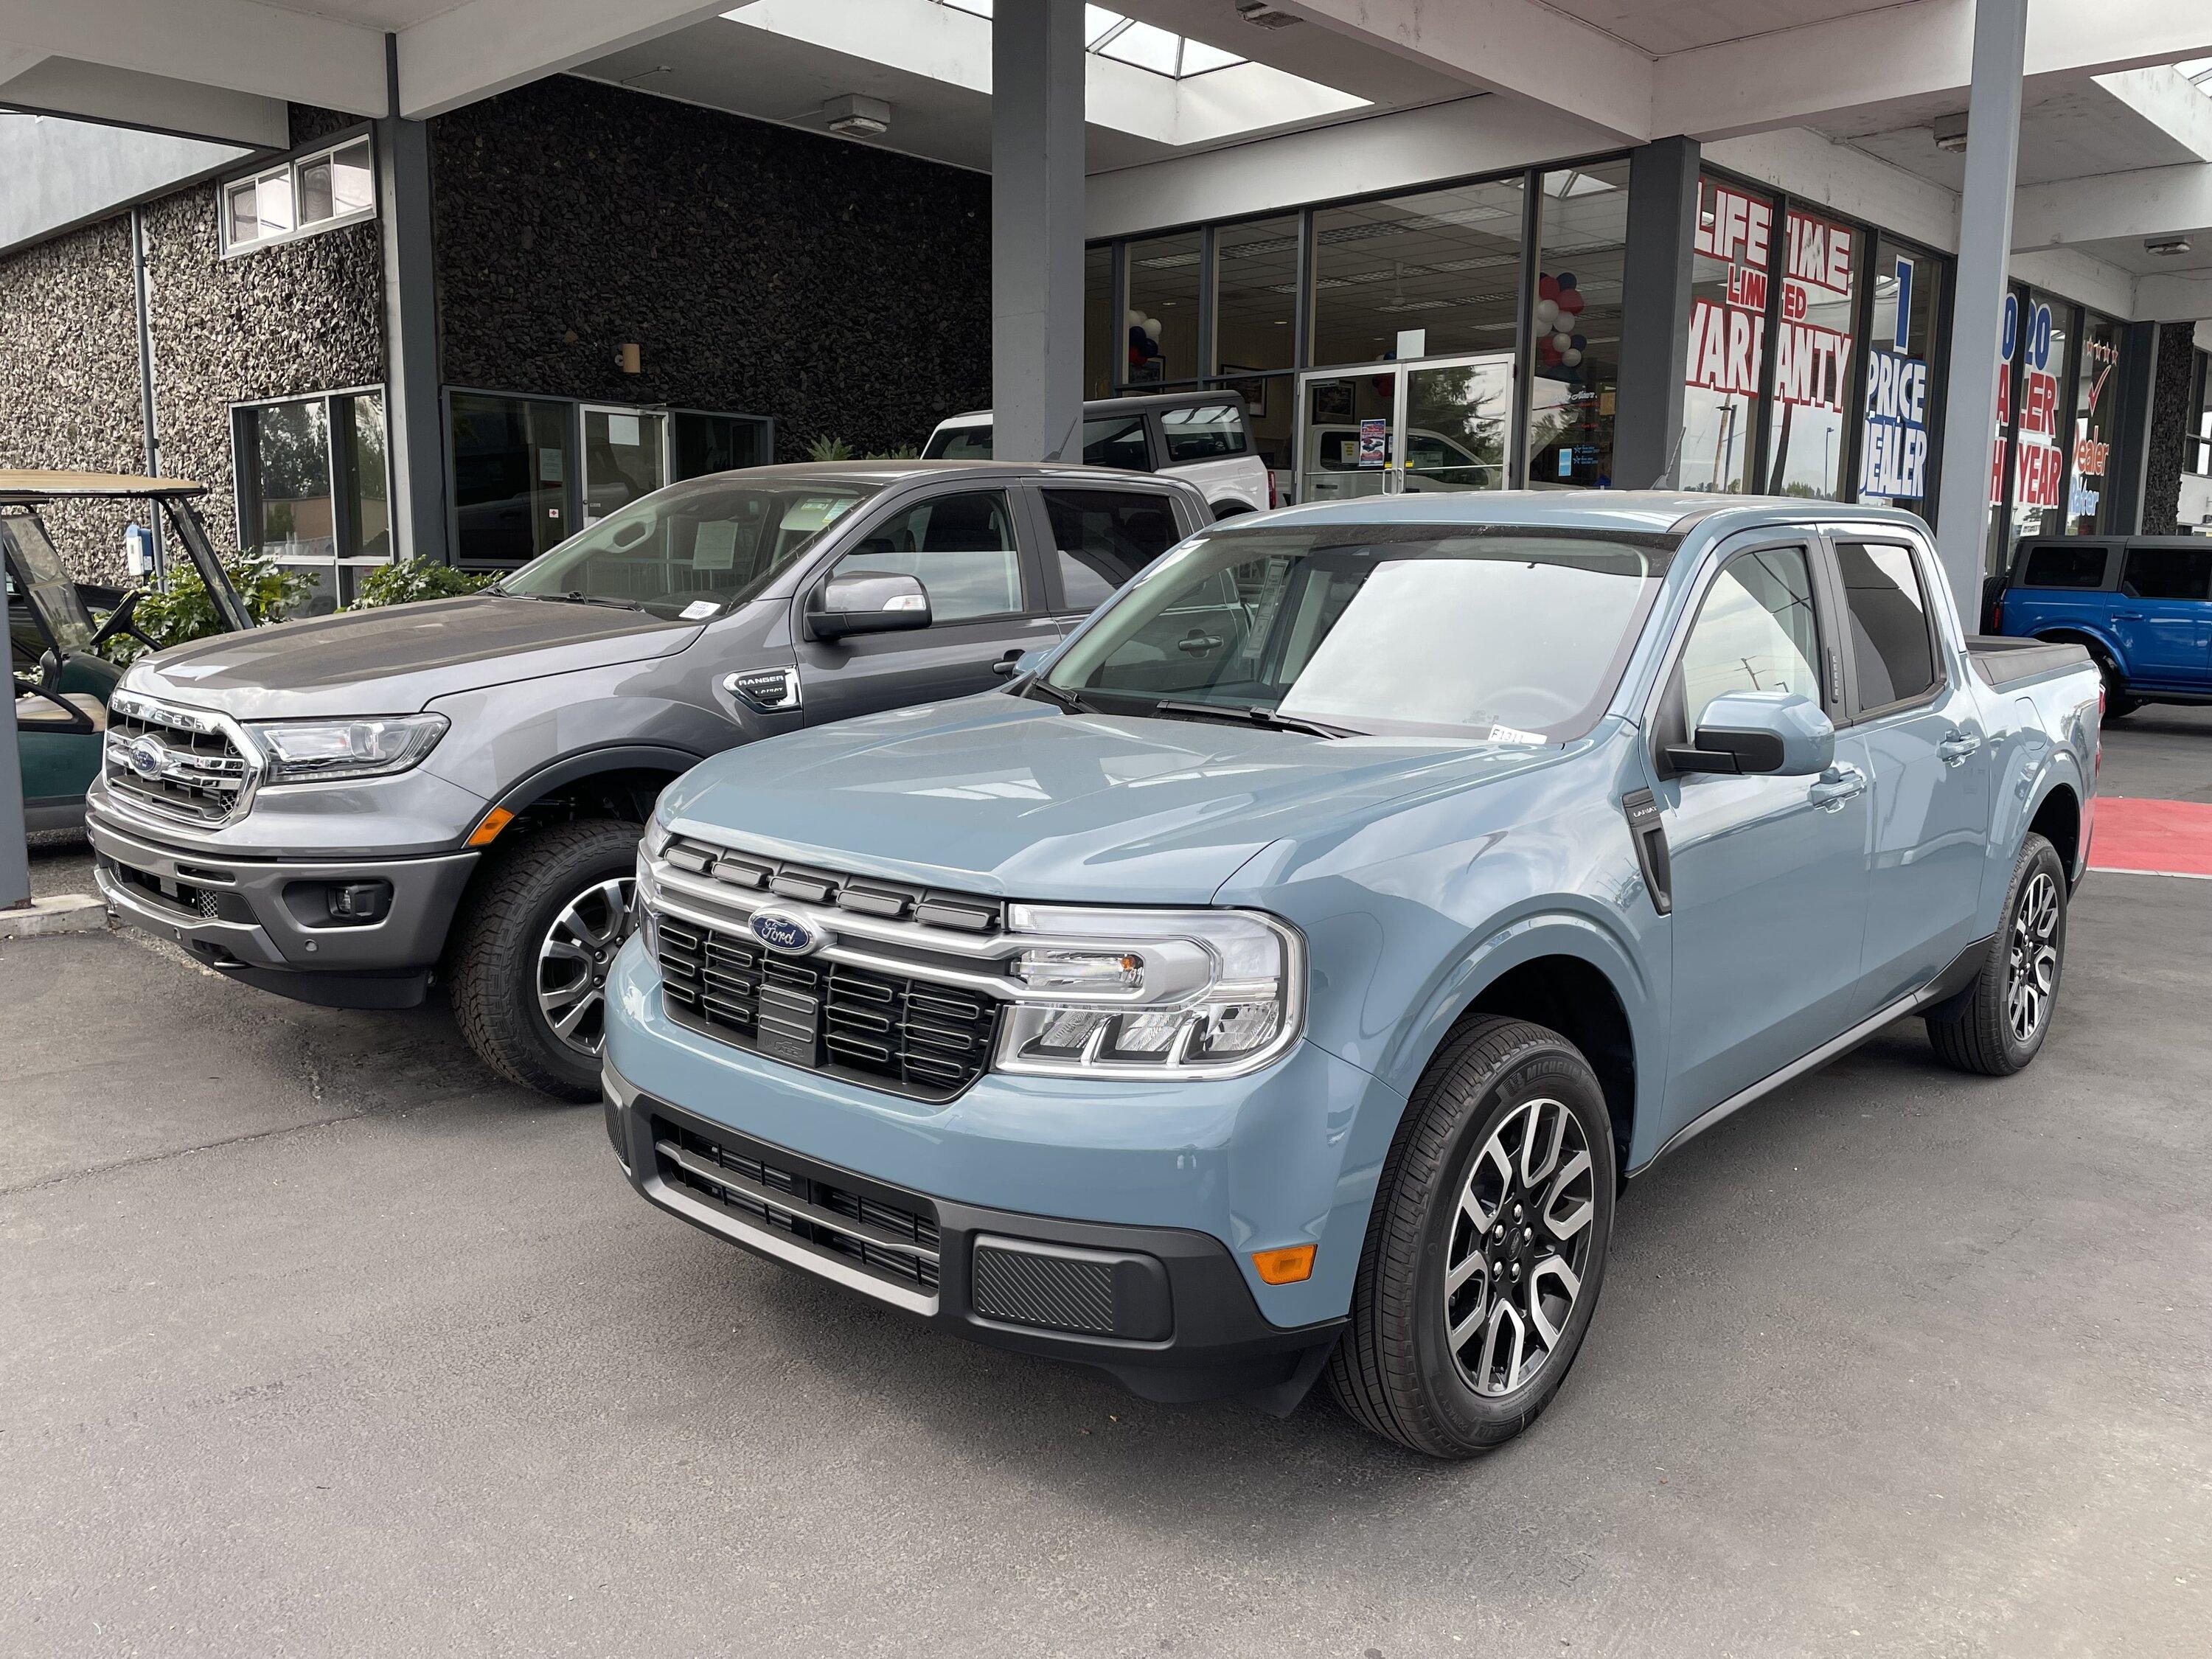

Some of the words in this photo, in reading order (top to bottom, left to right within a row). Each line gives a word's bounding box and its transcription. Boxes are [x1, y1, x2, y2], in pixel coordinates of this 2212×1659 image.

[1893, 254, 1914, 355] 1
[2018, 441, 2062, 509] YEAR
[738, 675, 784, 686] RANGER
[762, 918, 796, 945] Ford
